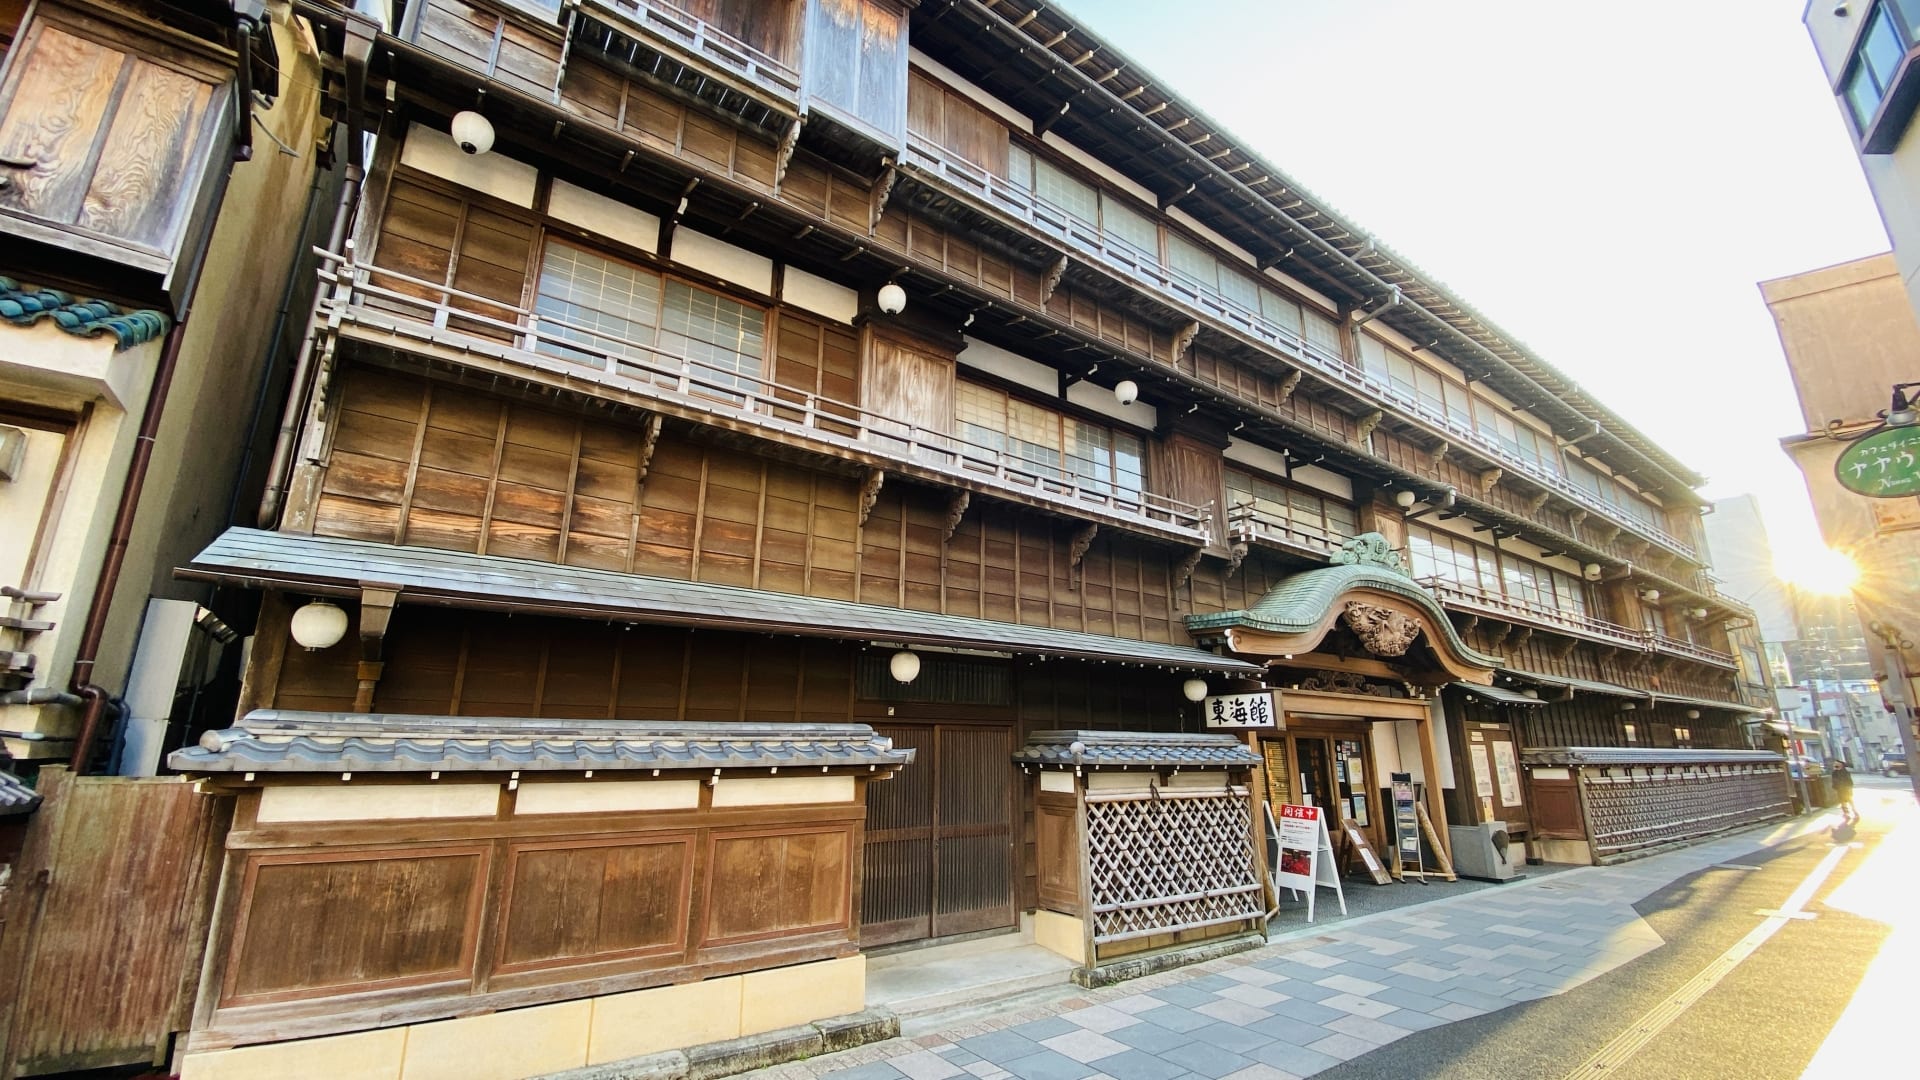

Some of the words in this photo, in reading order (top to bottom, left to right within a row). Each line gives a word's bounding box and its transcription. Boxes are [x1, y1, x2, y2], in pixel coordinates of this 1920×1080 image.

[1211, 696, 1268, 725] 東海館
[1284, 806, 1314, 819] 開催中
